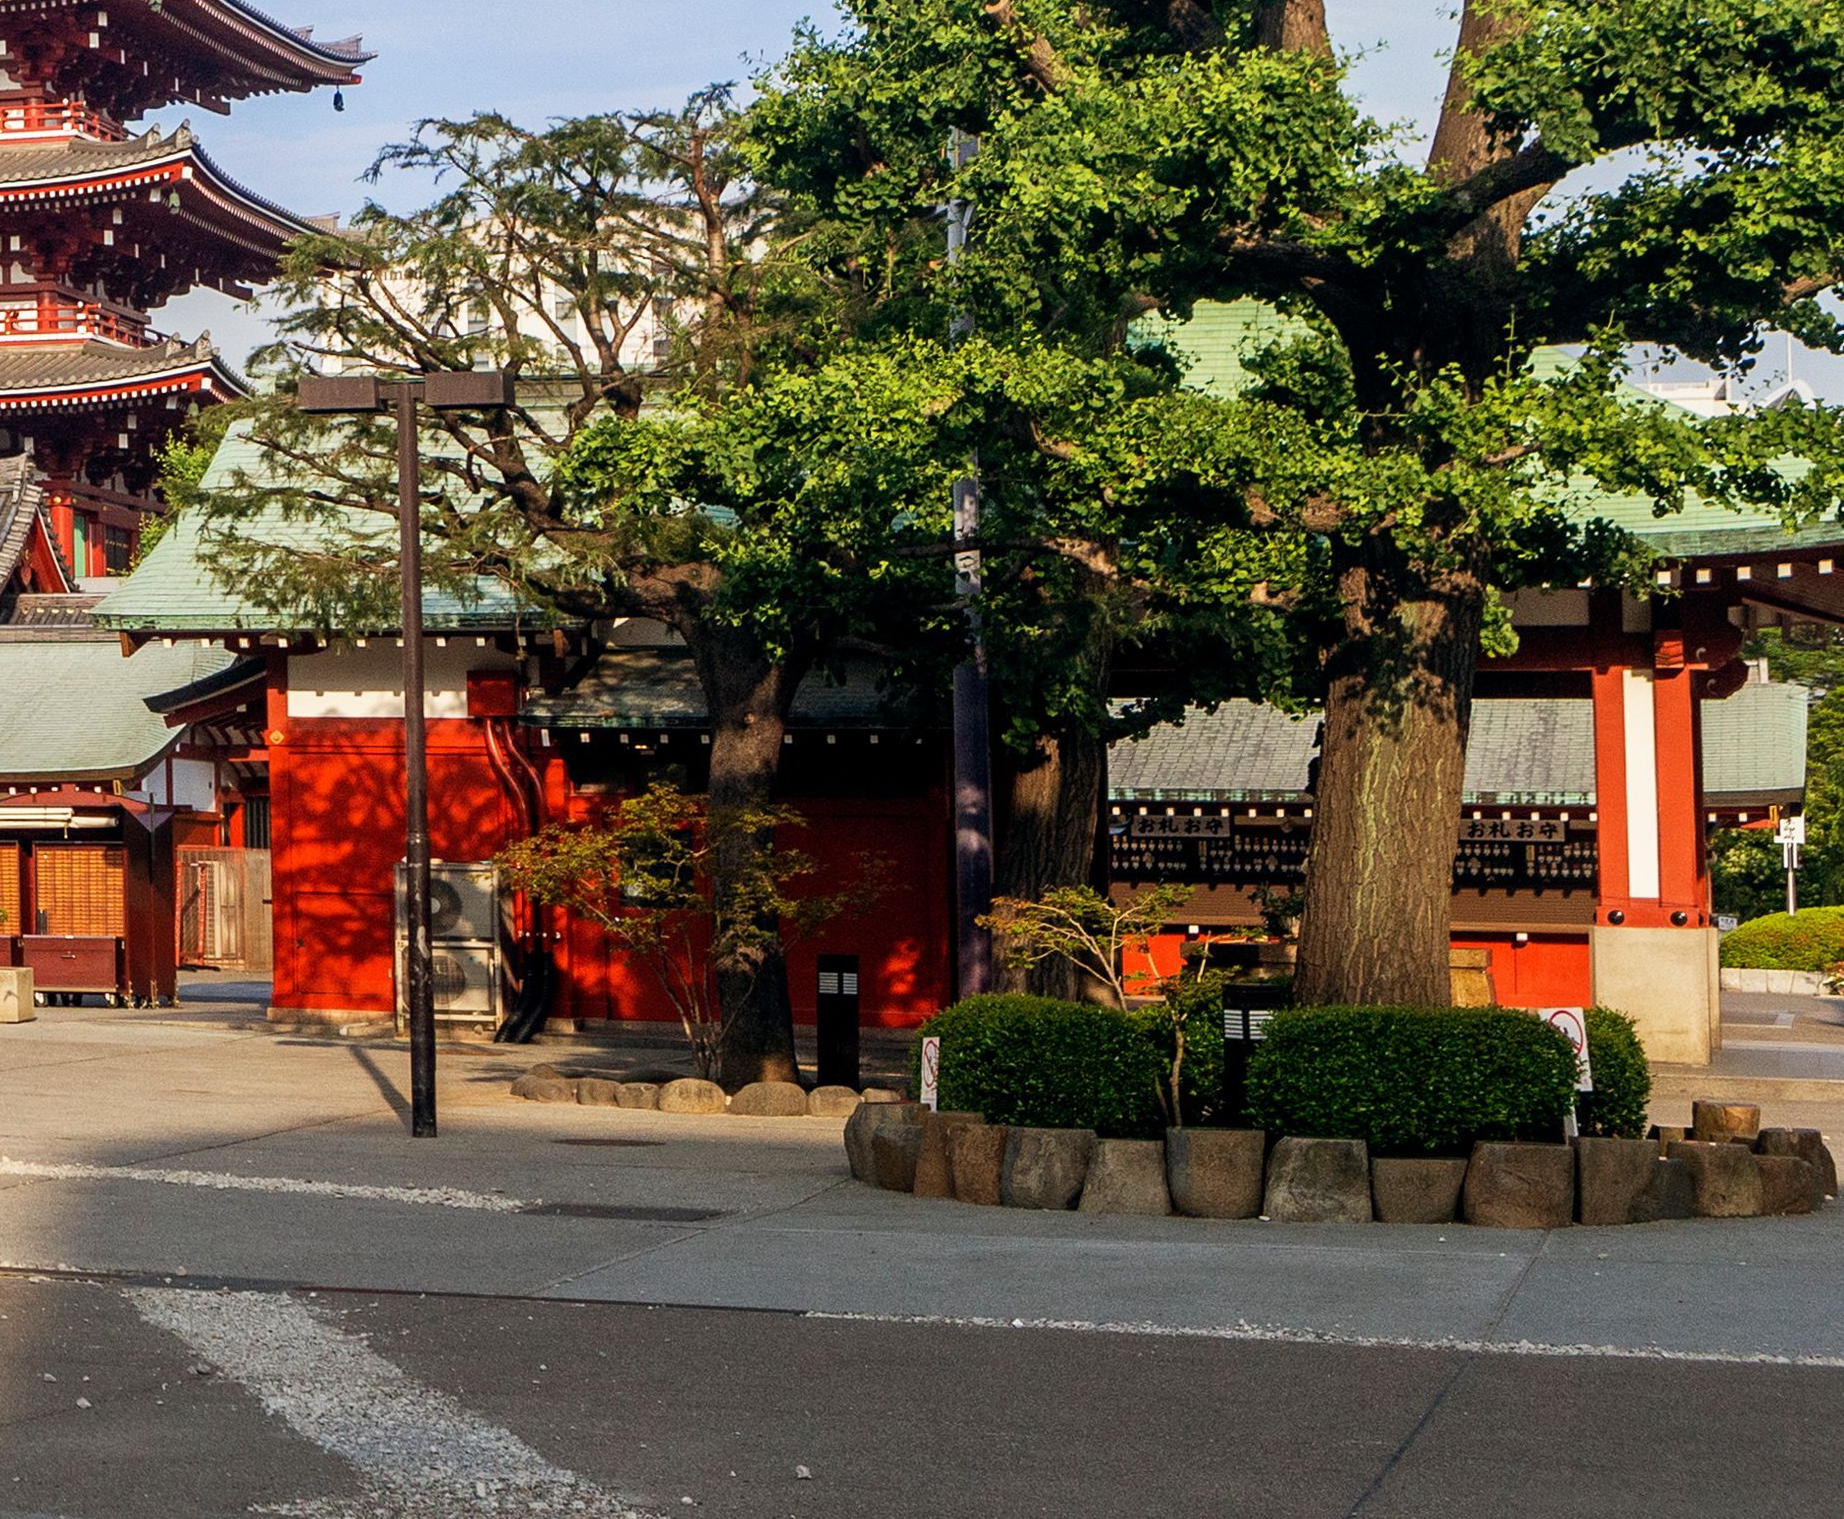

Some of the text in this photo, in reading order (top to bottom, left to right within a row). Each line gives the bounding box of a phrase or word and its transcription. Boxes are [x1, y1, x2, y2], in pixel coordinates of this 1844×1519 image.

[1138, 818, 1223, 835] お札お守
[1468, 821, 1558, 839] お札お守
